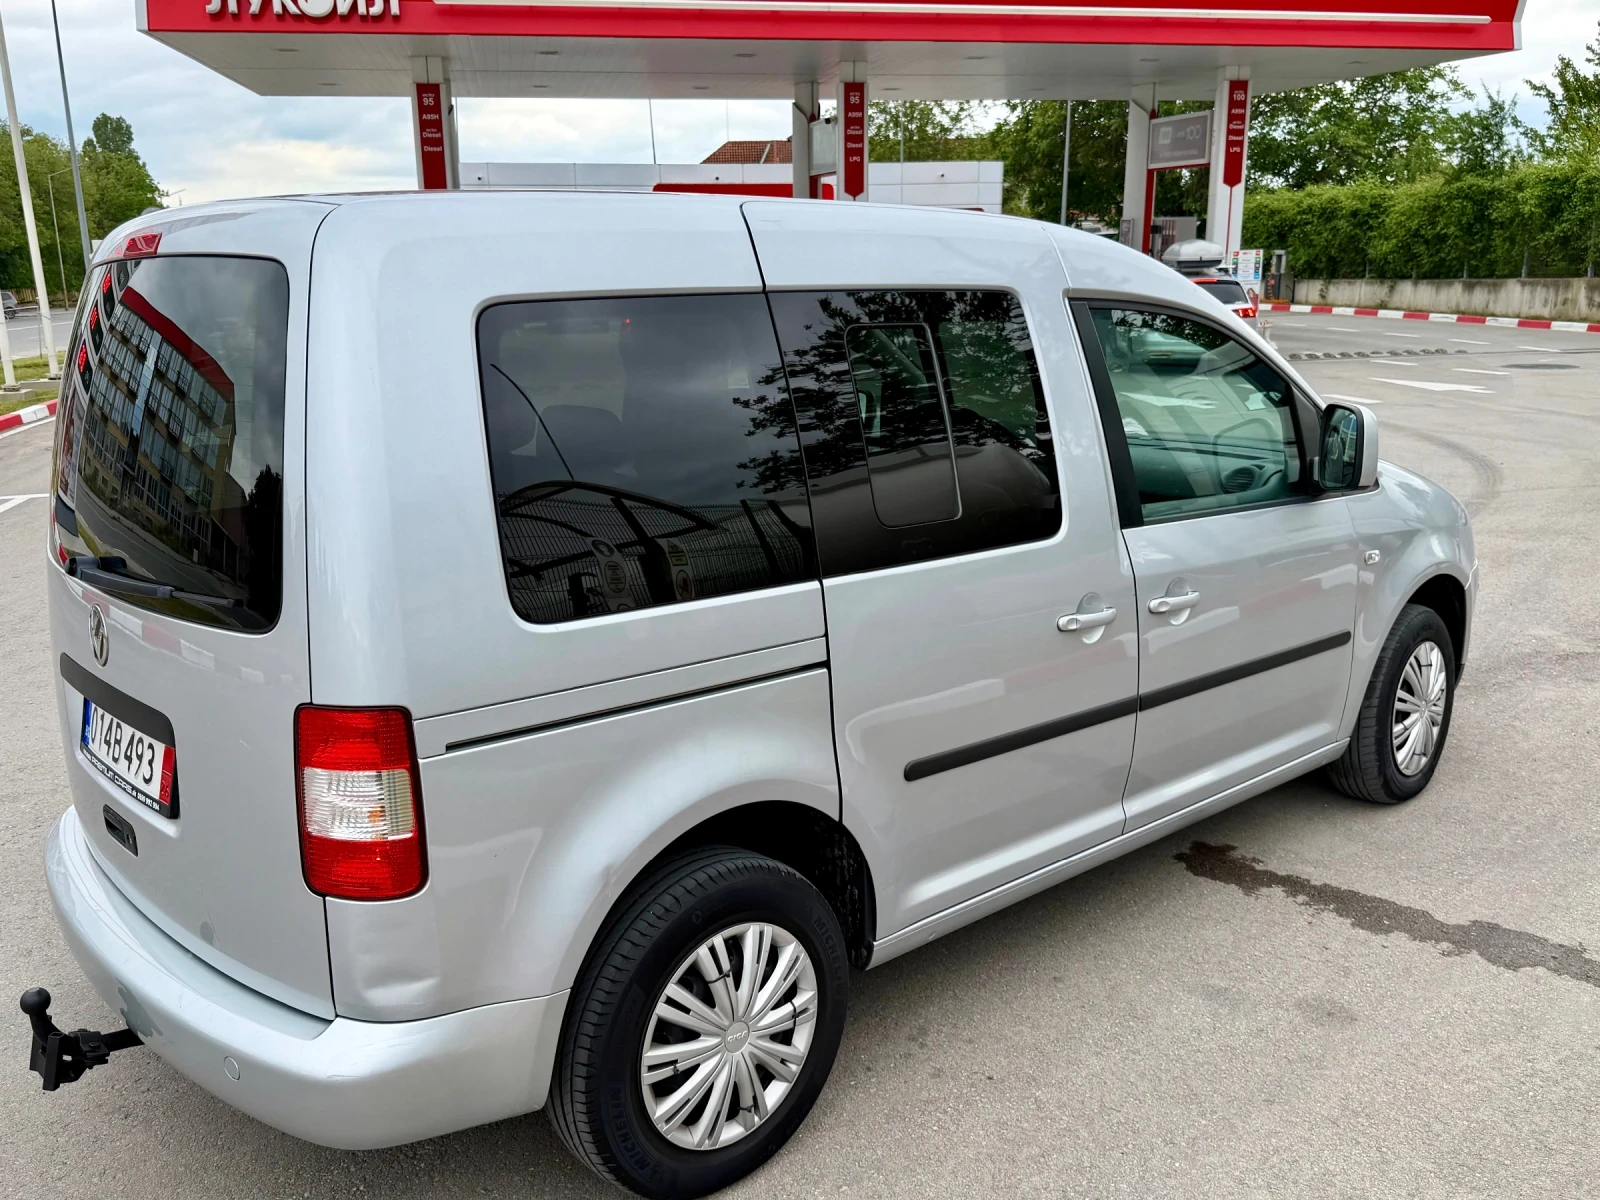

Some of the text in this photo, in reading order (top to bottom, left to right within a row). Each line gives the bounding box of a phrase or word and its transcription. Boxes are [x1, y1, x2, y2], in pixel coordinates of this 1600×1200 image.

[850, 96, 860, 104] 95
[91, 705, 156, 785] 014B 493
